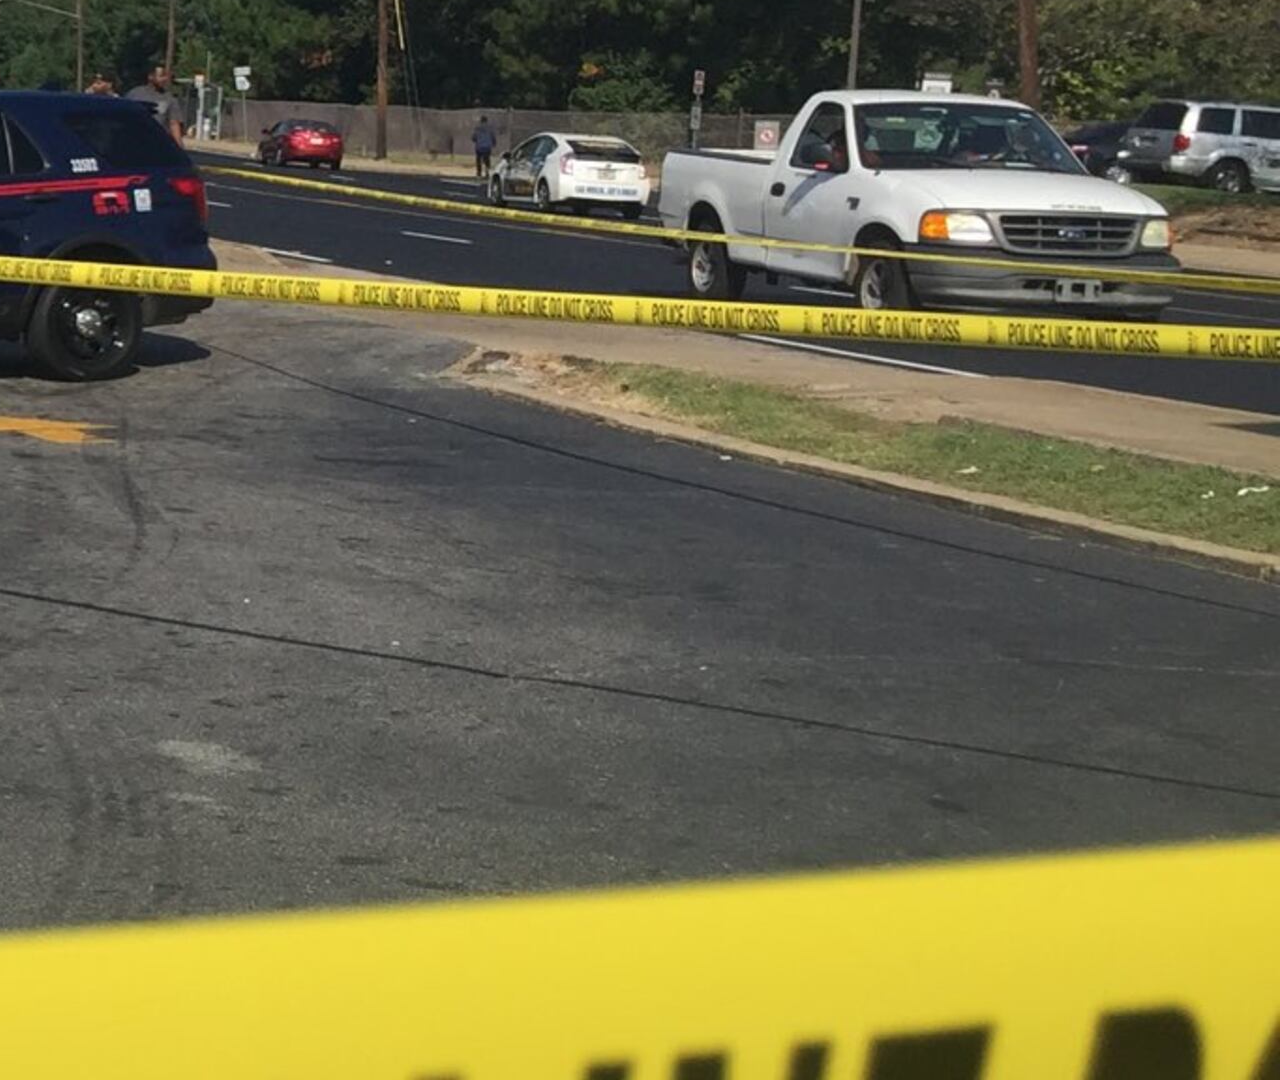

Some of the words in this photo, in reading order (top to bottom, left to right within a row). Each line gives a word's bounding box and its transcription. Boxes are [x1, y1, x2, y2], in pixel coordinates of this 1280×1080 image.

[651, 303, 685, 327] POLICE
[686, 305, 708, 328] LINE
[725, 307, 744, 330] NOT
[746, 308, 780, 332] CROSS
[822, 312, 857, 335] POLICE
[860, 314, 882, 337] LINE
[884, 315, 900, 338] DO
[902, 317, 923, 340] NOT
[925, 318, 961, 343] CROSS
[1007, 323, 1047, 348] POLICE
[1049, 325, 1074, 349] LINE
[1075, 326, 1093, 350] DO
[1096, 327, 1118, 351] NOT
[1121, 328, 1160, 353] CROSS
[1210, 333, 1254, 358] POLICE
